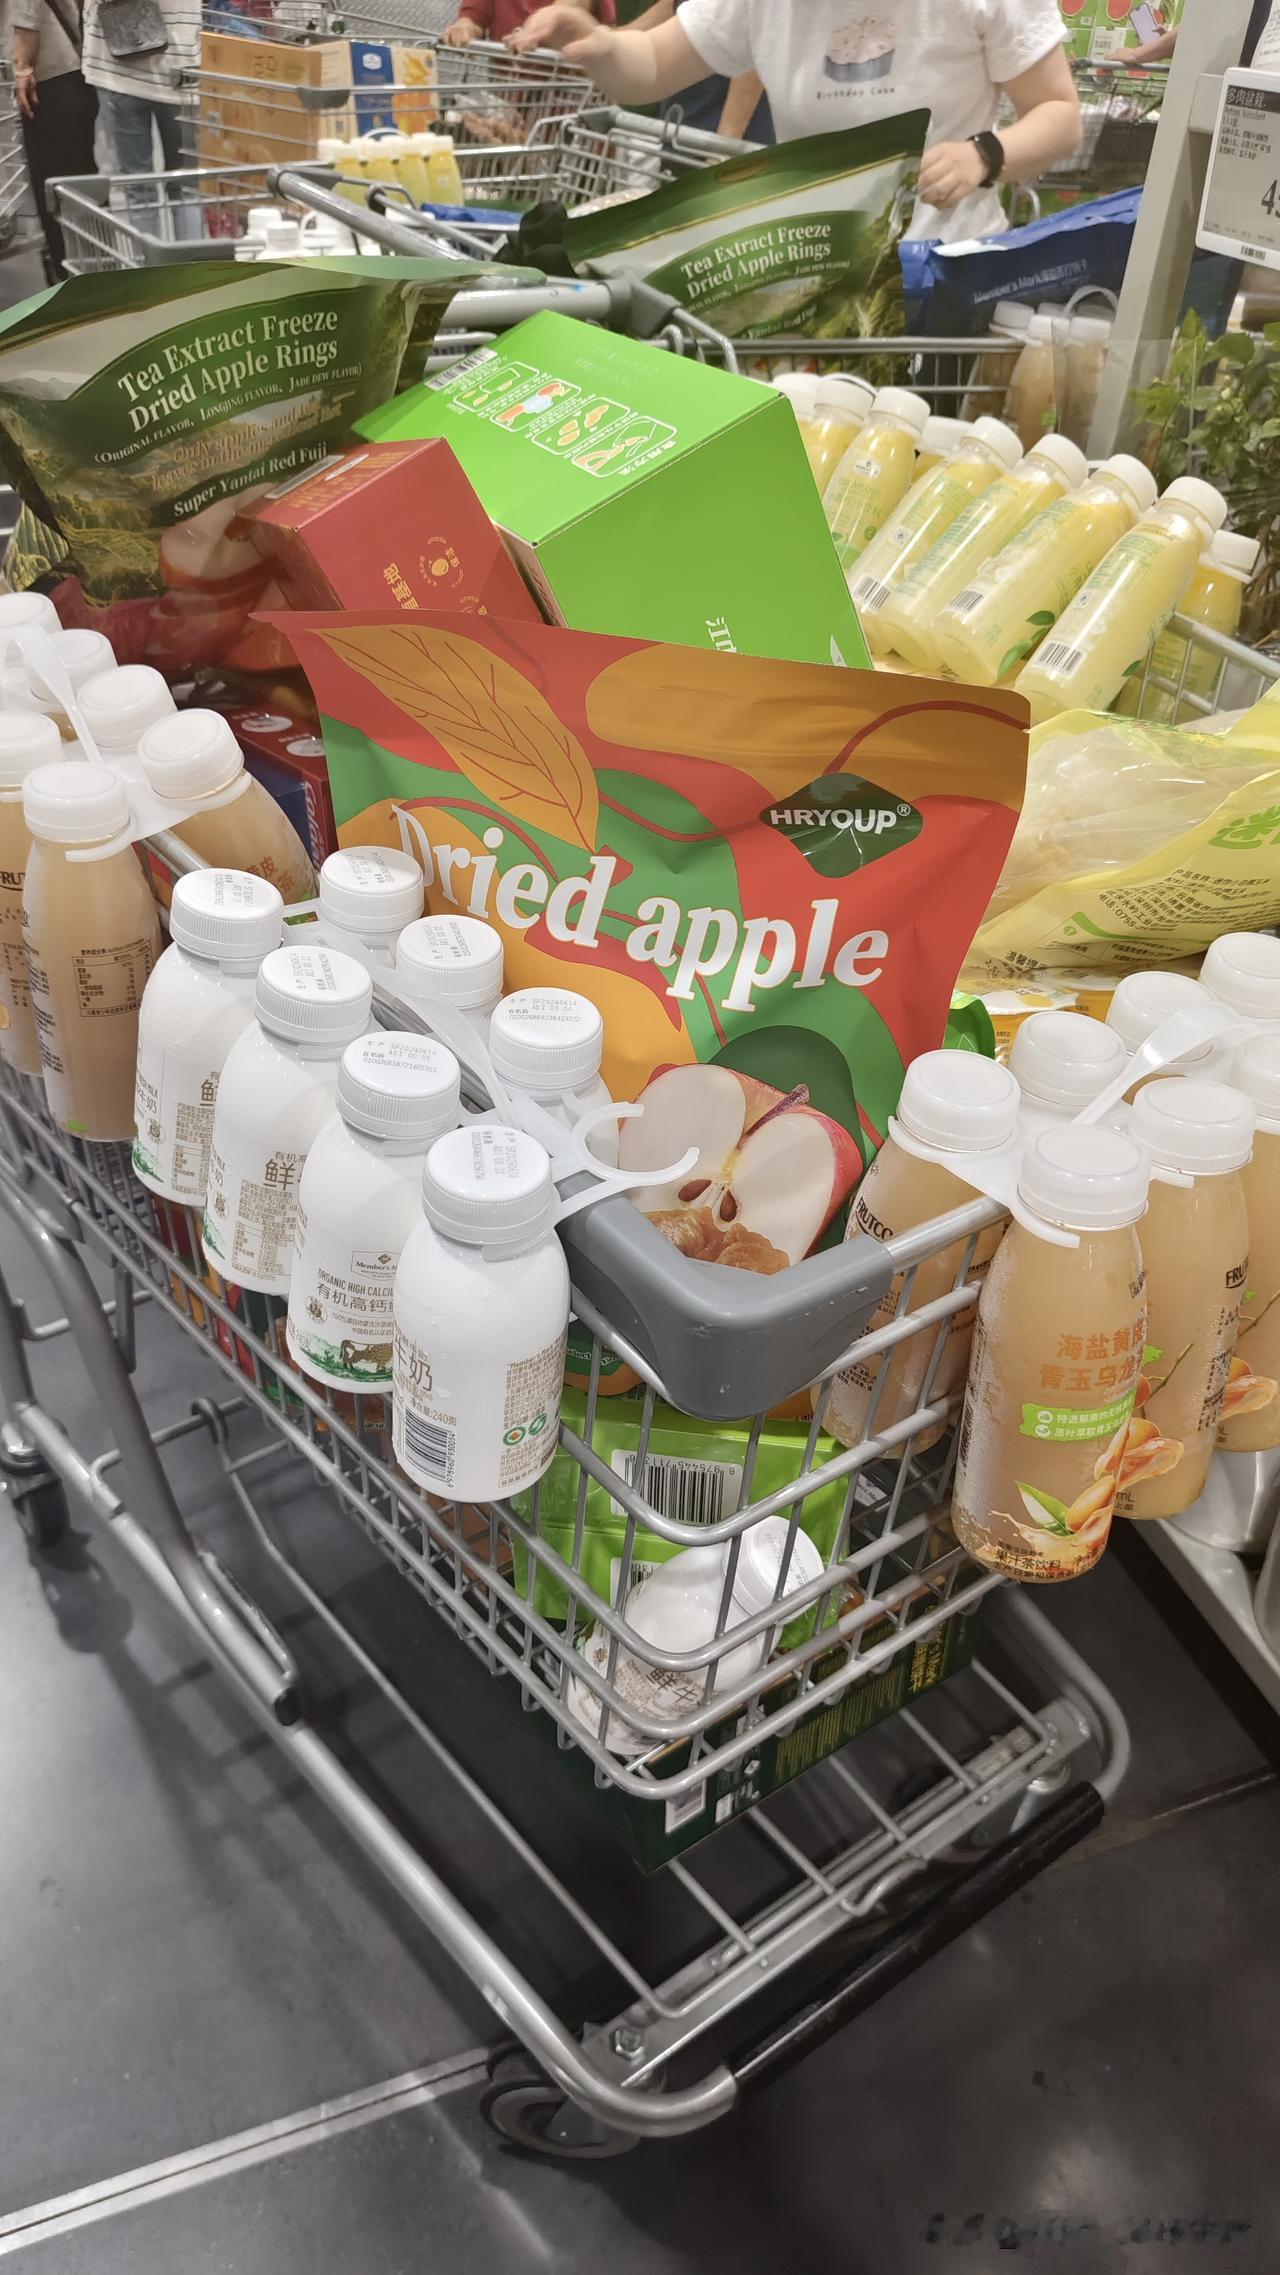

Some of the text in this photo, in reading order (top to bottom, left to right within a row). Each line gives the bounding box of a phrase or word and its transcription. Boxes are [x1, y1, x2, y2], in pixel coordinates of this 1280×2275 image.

[681, 223, 831, 280] Tea Extract Freeze
[687, 242, 831, 299] Dried Apple Rings
[117, 311, 338, 402] Tea Extract Freeze
[127, 340, 338, 433] Dried Apple Rings
[174, 442, 328, 517] Super Yantai Red Fuji
[390, 802, 889, 1013] Dried apple
[318, 1268, 347, 1290] ORGANIC
[347, 1281, 366, 1295] HIGH
[355, 1260, 390, 1271] Member's
[317, 1282, 394, 1313] 有机高钙
[677, 1460, 721, 1475] 975445
[994, 1548, 1062, 1572] 果汁茶饮料
